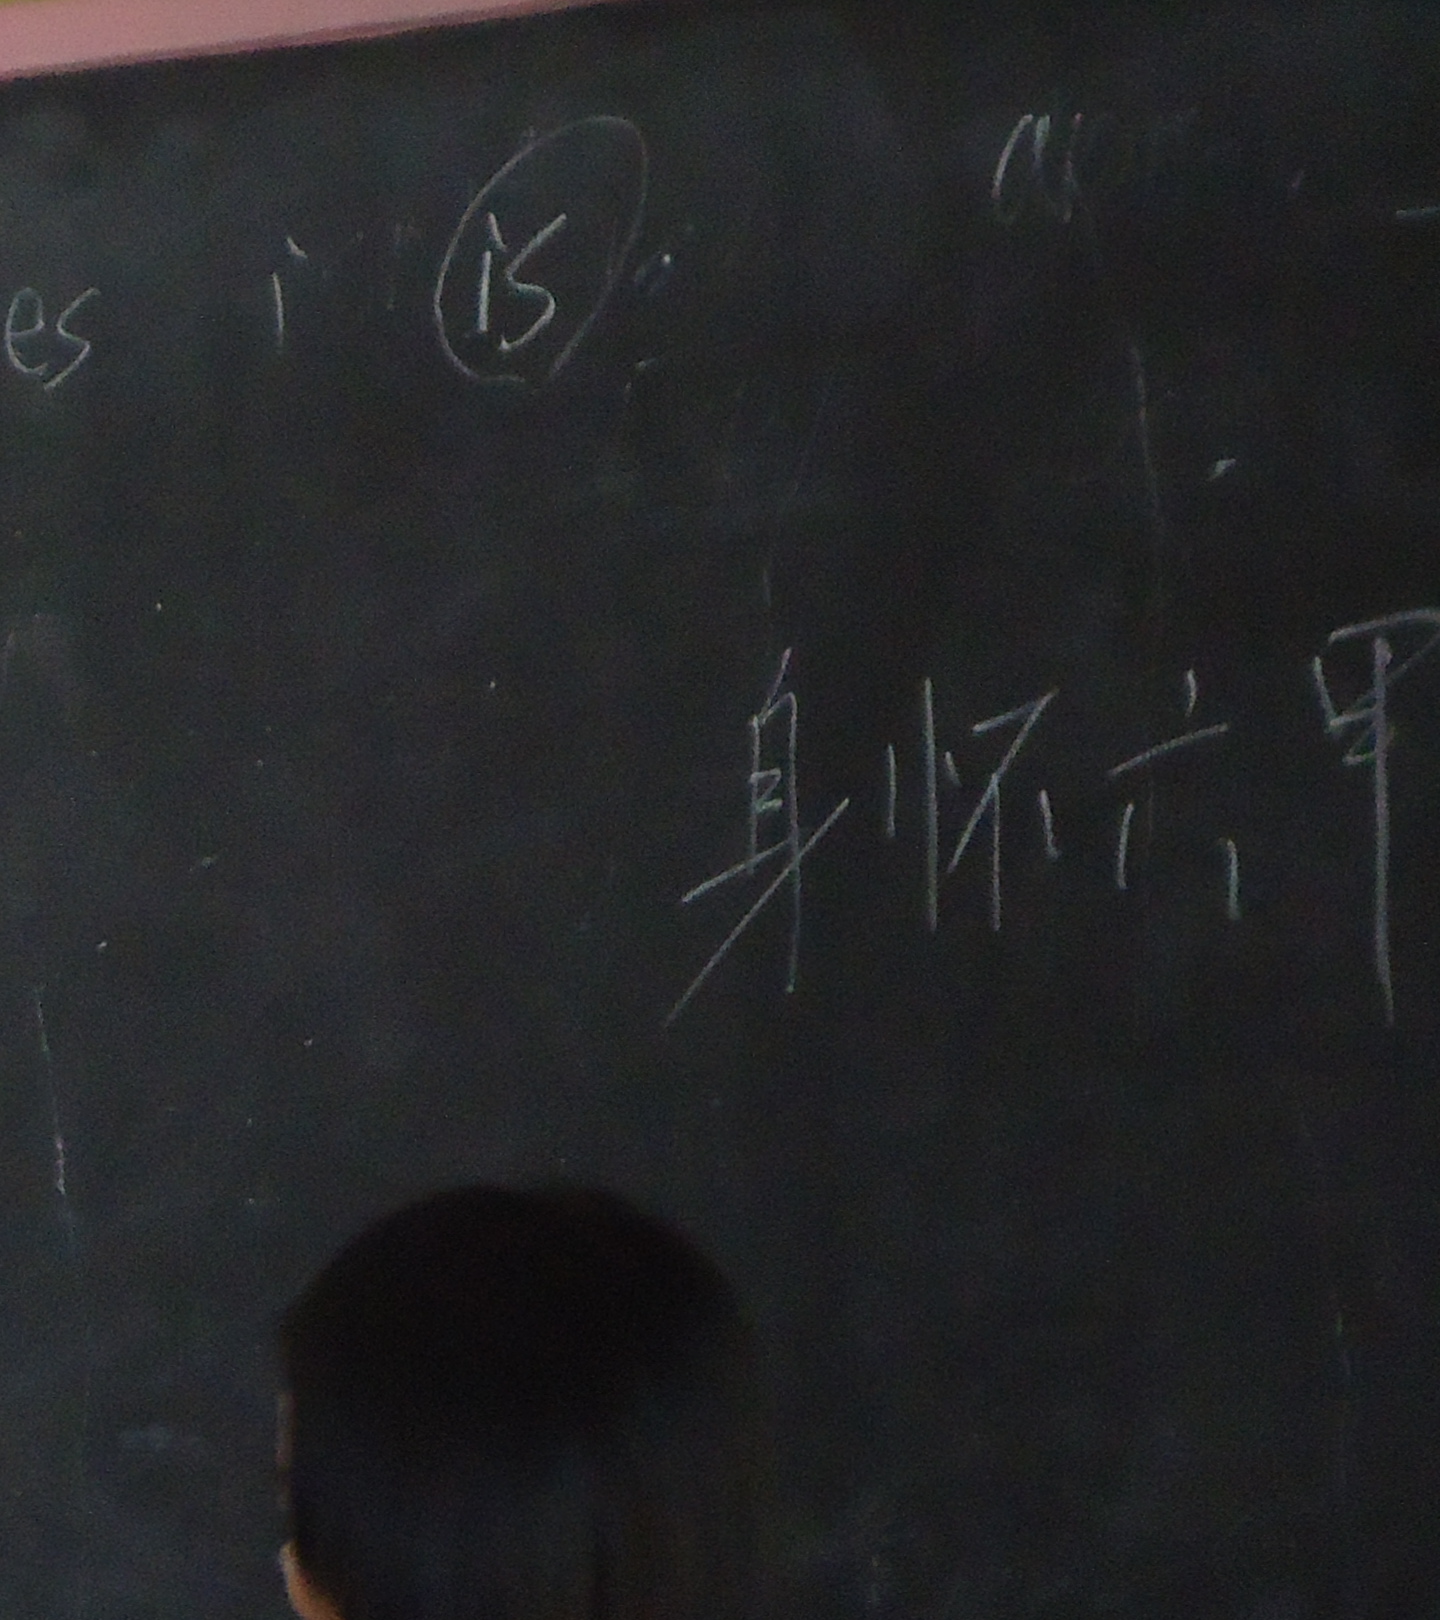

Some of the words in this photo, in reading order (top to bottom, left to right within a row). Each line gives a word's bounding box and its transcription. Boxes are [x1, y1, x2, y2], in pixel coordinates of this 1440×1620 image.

[6, 287, 102, 391] es
[665, 607, 1440, 1028] 身怀六甲
